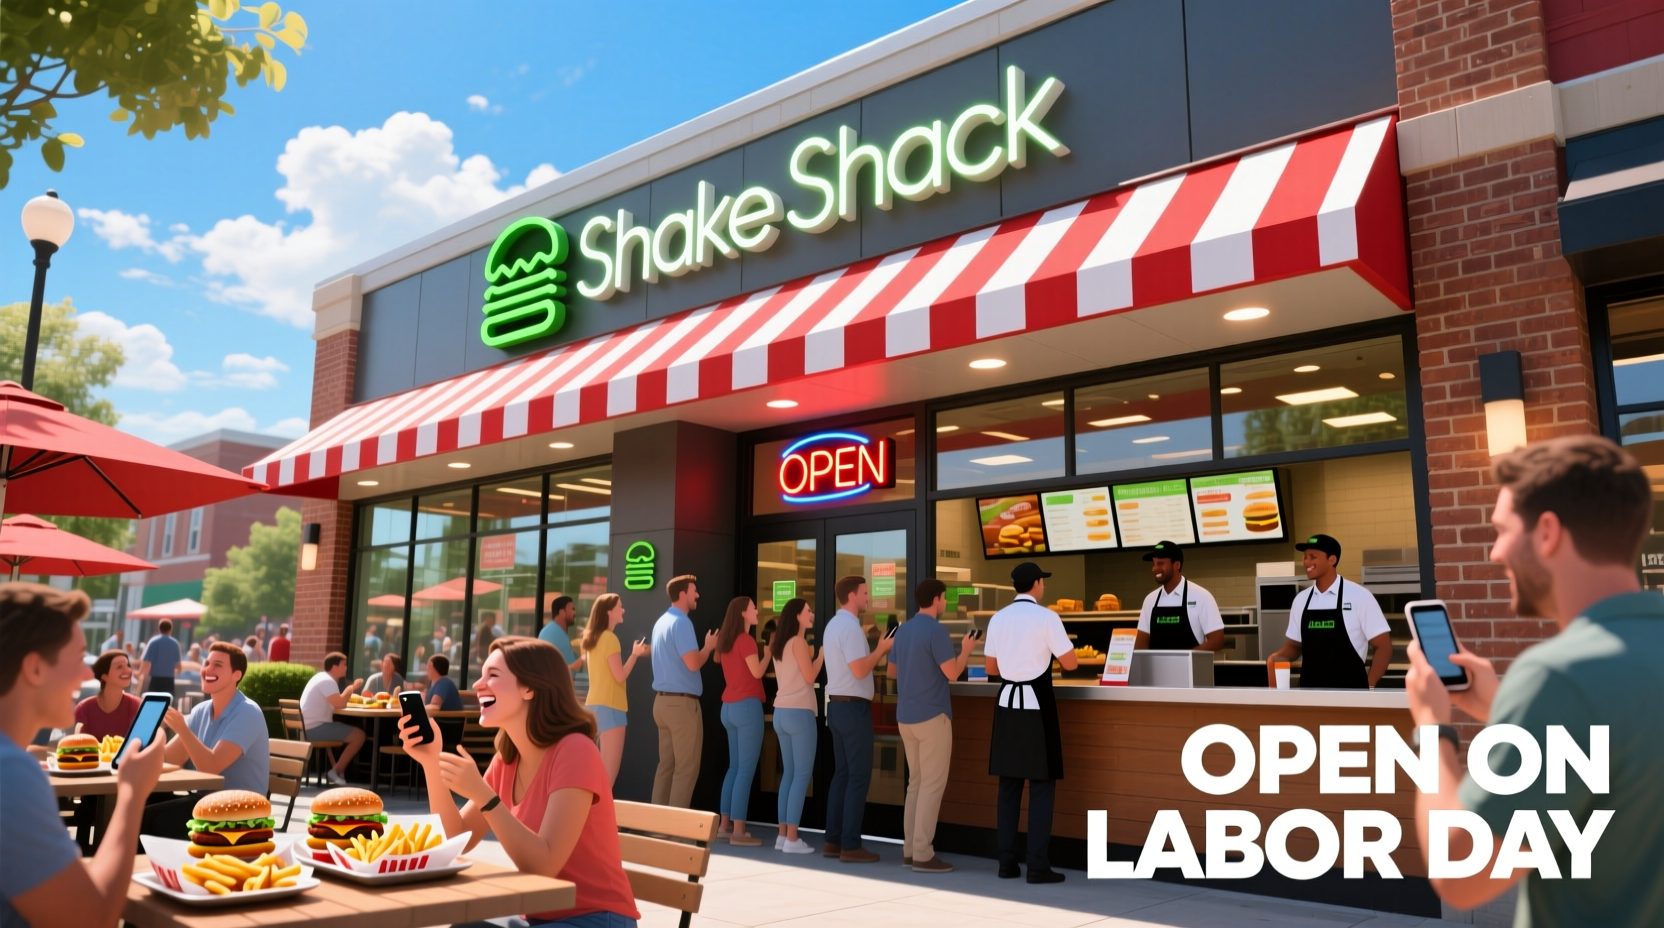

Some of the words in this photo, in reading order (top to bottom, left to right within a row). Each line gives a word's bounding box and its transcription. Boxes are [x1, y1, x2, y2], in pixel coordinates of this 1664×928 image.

[577, 180, 783, 301] Shake
[787, 64, 1071, 235] Shack
[778, 437, 886, 494] OPEN
